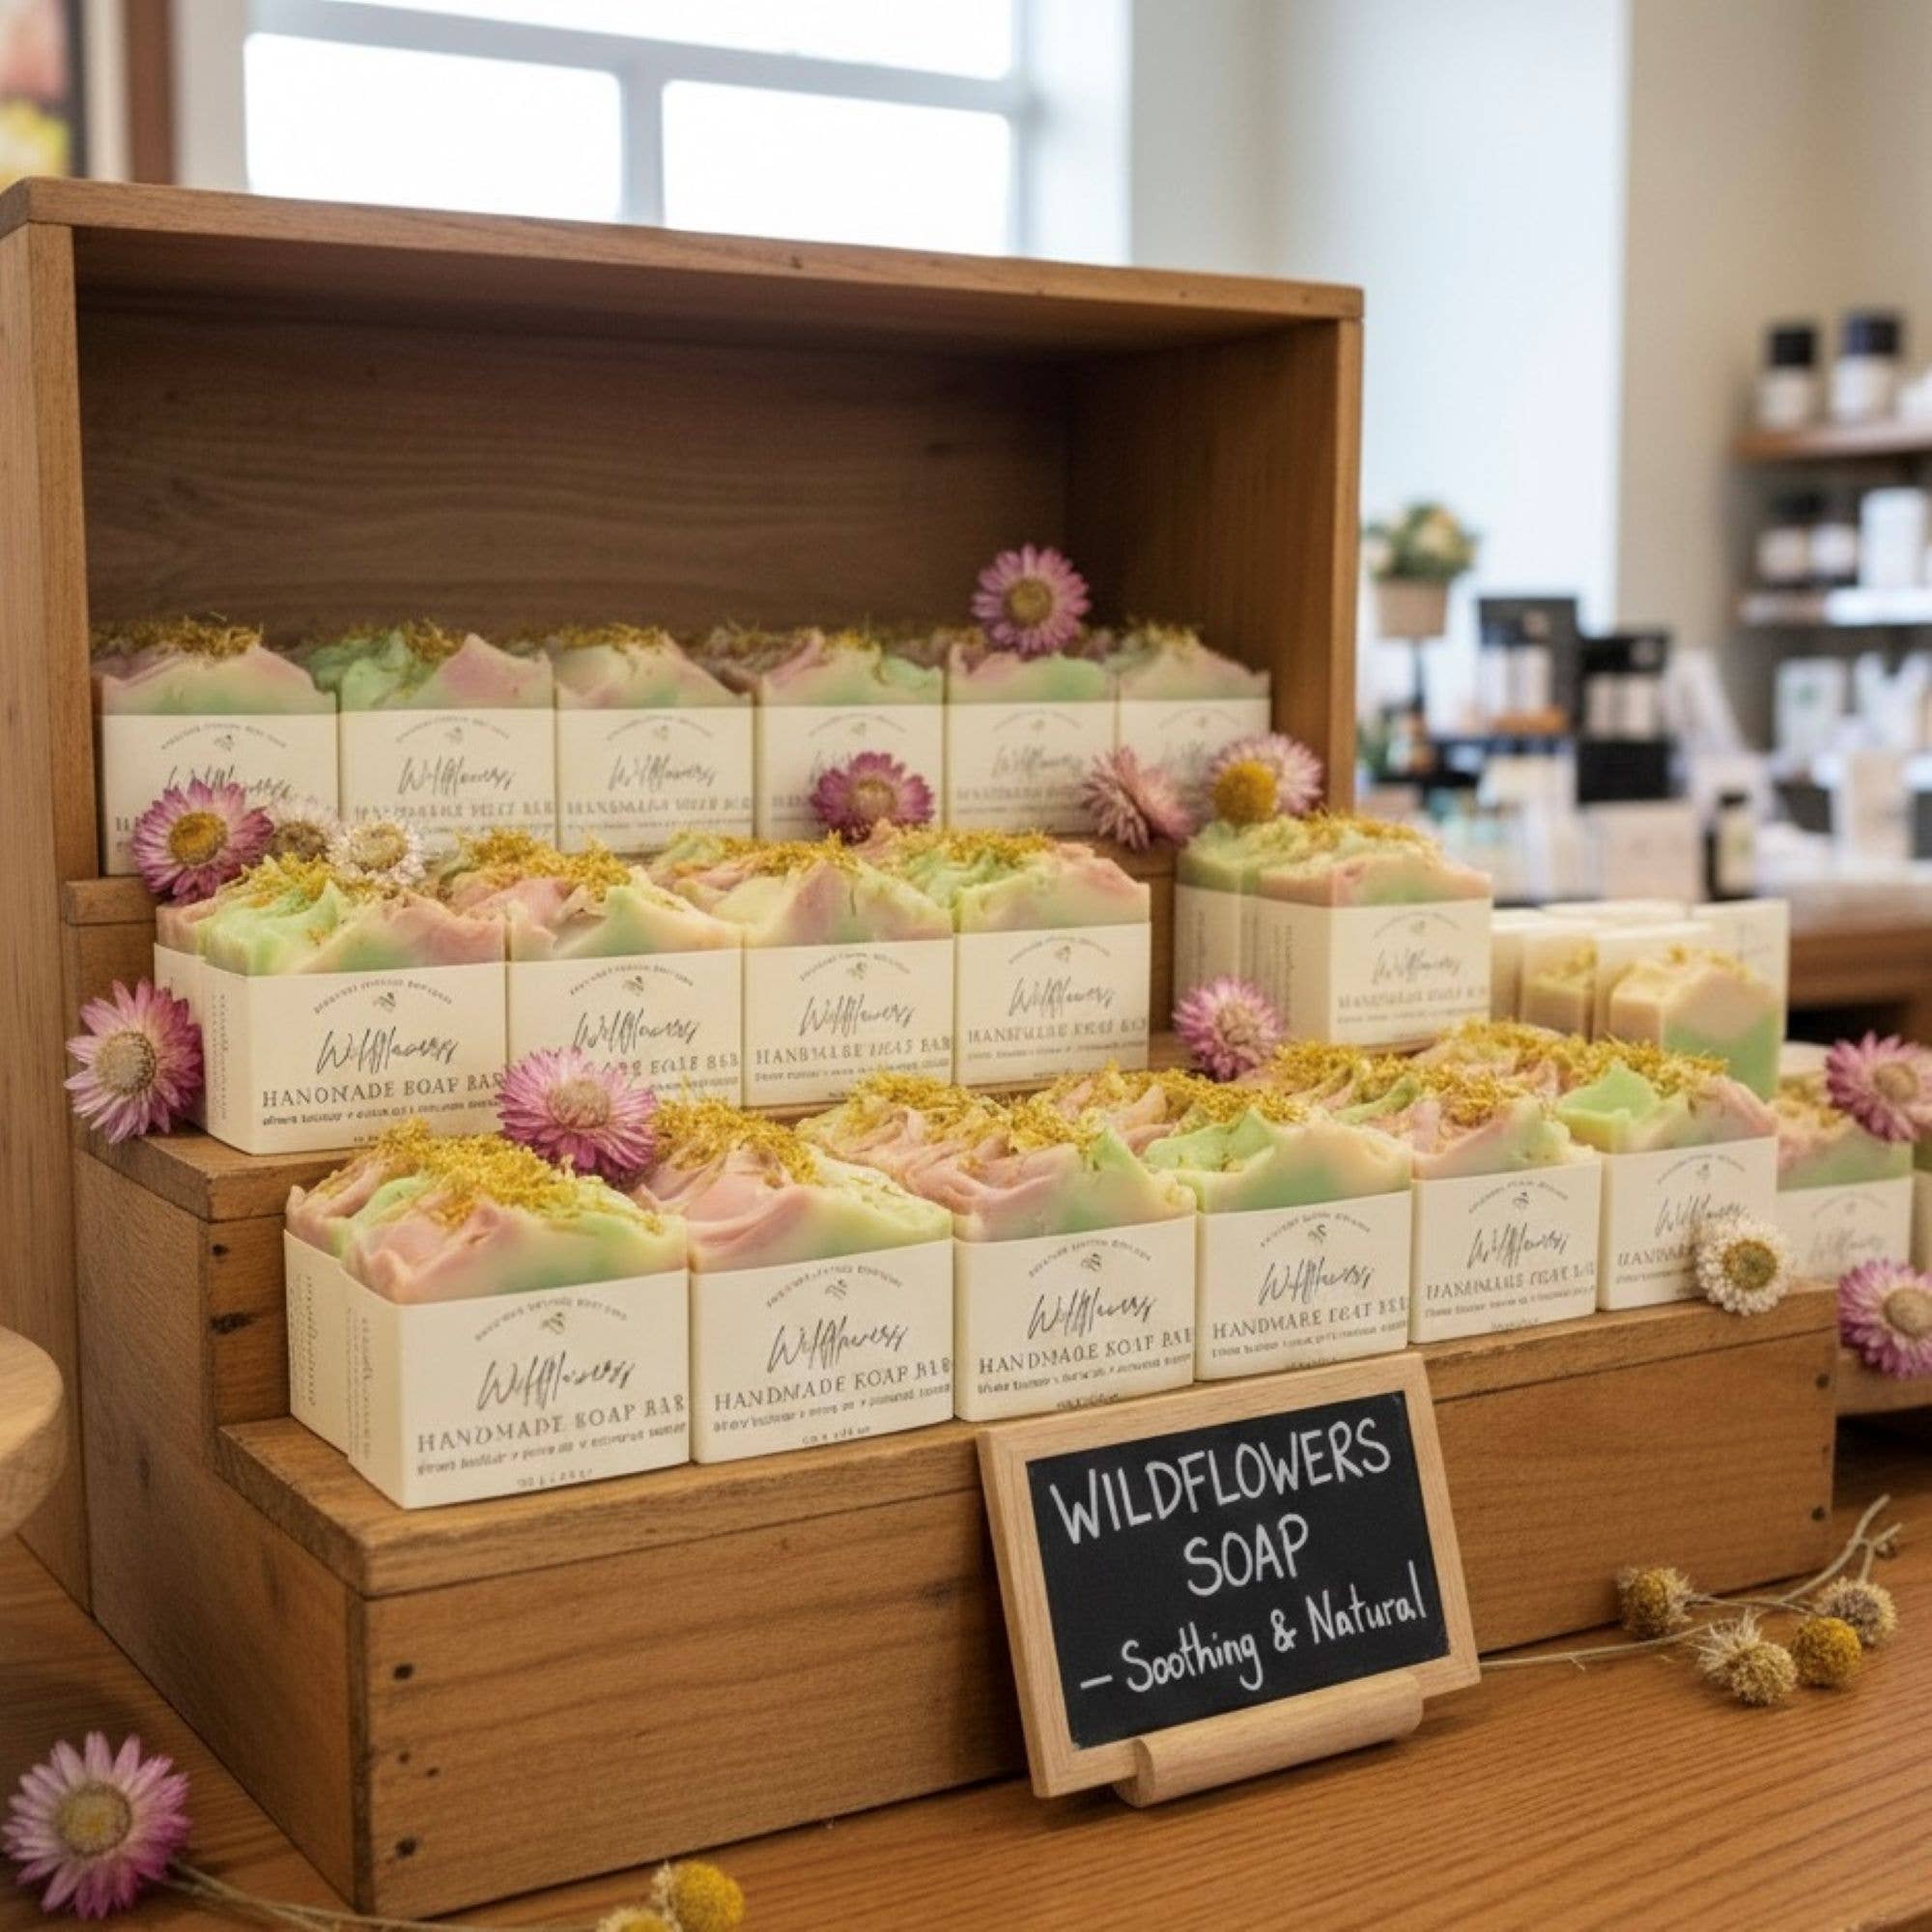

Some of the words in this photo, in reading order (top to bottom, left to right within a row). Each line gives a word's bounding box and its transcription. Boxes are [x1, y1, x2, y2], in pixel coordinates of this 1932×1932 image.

[1049, 1417, 1392, 1545] WILDFLOWERS
[1182, 1512, 1309, 1597] SOAP
[1121, 1621, 1264, 1692] Soothing
[1269, 1608, 1297, 1653] &
[1305, 1559, 1428, 1644] Natural
